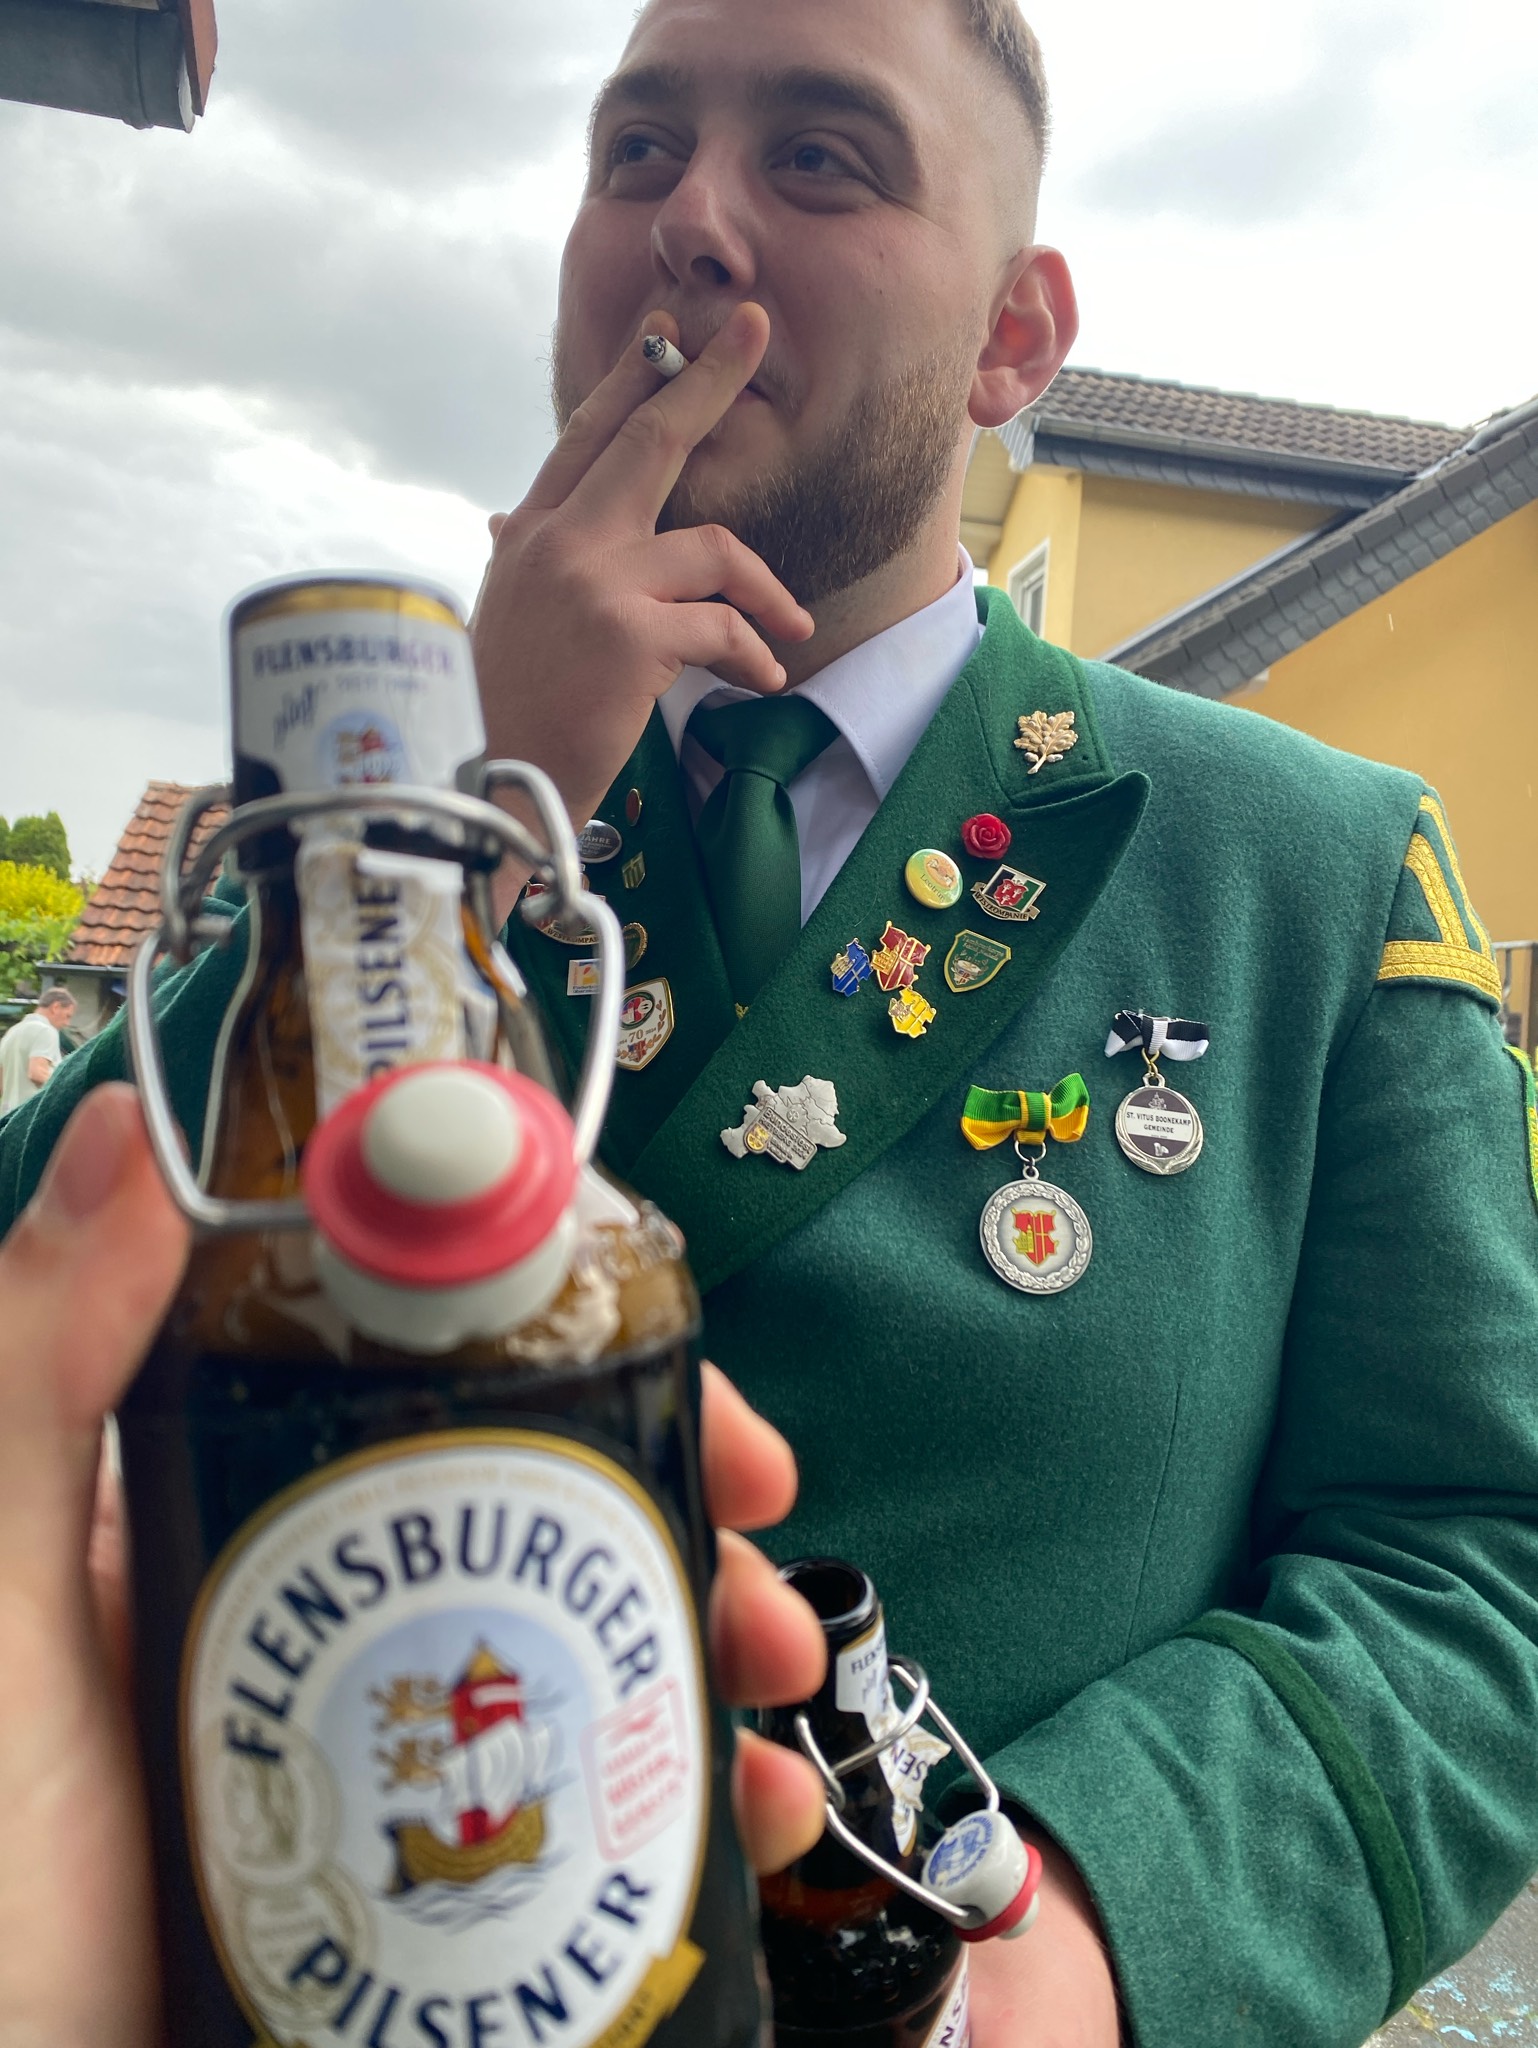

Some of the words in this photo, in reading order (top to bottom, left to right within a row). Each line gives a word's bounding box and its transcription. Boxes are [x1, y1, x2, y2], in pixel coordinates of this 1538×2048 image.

[629, 1029, 643, 1042] 70
[1137, 1113, 1154, 1122] VITUS
[1155, 1115, 1192, 1126] BOONEKAMP
[1143, 1124, 1175, 1134] GEMEINDE
[223, 1502, 662, 1763] FLENSBURGER
[287, 1867, 654, 2048] PILSENER
